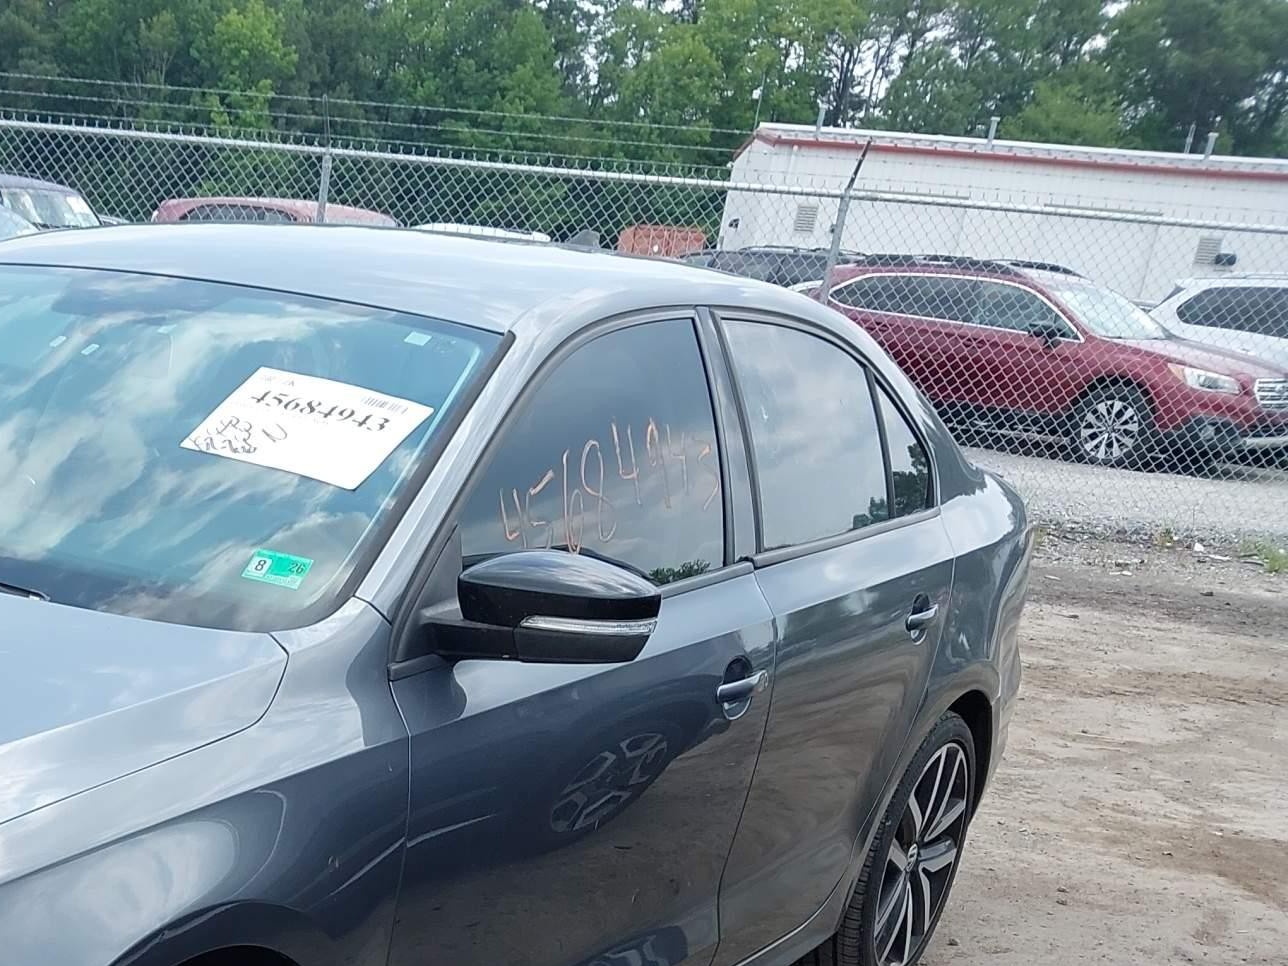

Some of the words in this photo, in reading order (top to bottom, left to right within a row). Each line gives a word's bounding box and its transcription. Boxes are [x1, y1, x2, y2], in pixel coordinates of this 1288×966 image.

[250, 390, 391, 432] 45684943
[499, 416, 721, 554] 45684943
[254, 559, 268, 572] 8
[288, 561, 306, 575] 26
